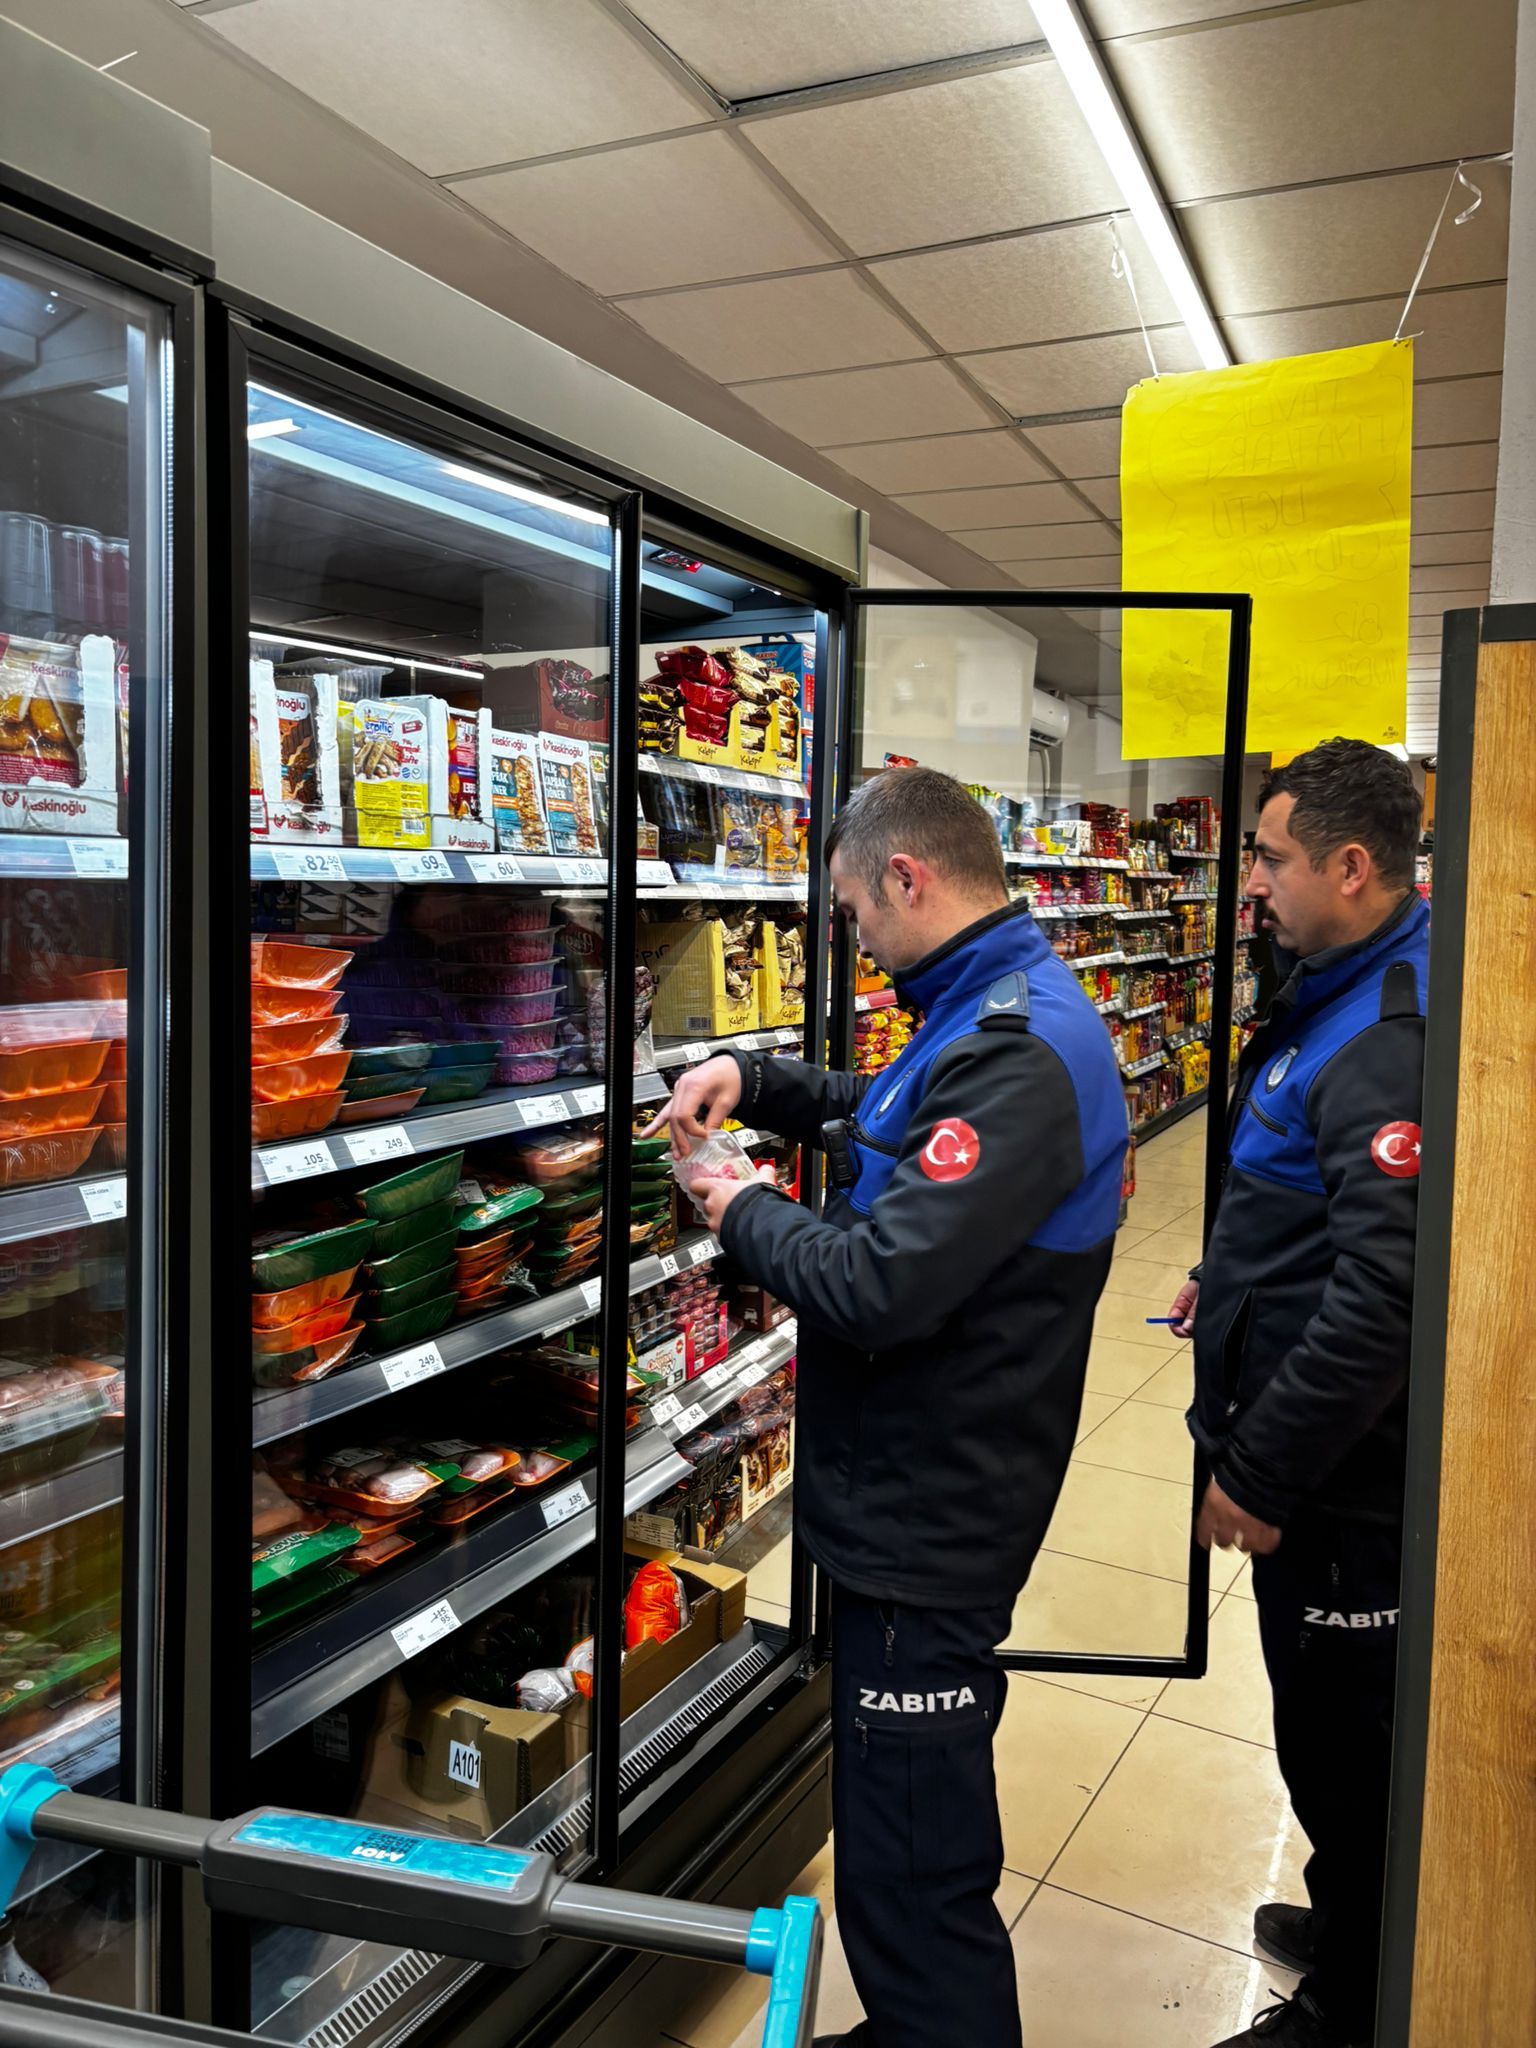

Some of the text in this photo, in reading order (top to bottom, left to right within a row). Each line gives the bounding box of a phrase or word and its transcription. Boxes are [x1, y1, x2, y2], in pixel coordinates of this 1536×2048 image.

[276, 695, 306, 713] inoğlu
[421, 855, 438, 870] 69
[497, 861, 514, 875] 60
[384, 1138, 403, 1149] 249
[304, 1152, 324, 1165] 105
[418, 1354, 435, 1368] 249
[1303, 1606, 1400, 1628] ZABIT
[859, 1686, 976, 1713] ZABITA
[452, 1748, 480, 1783] A101
